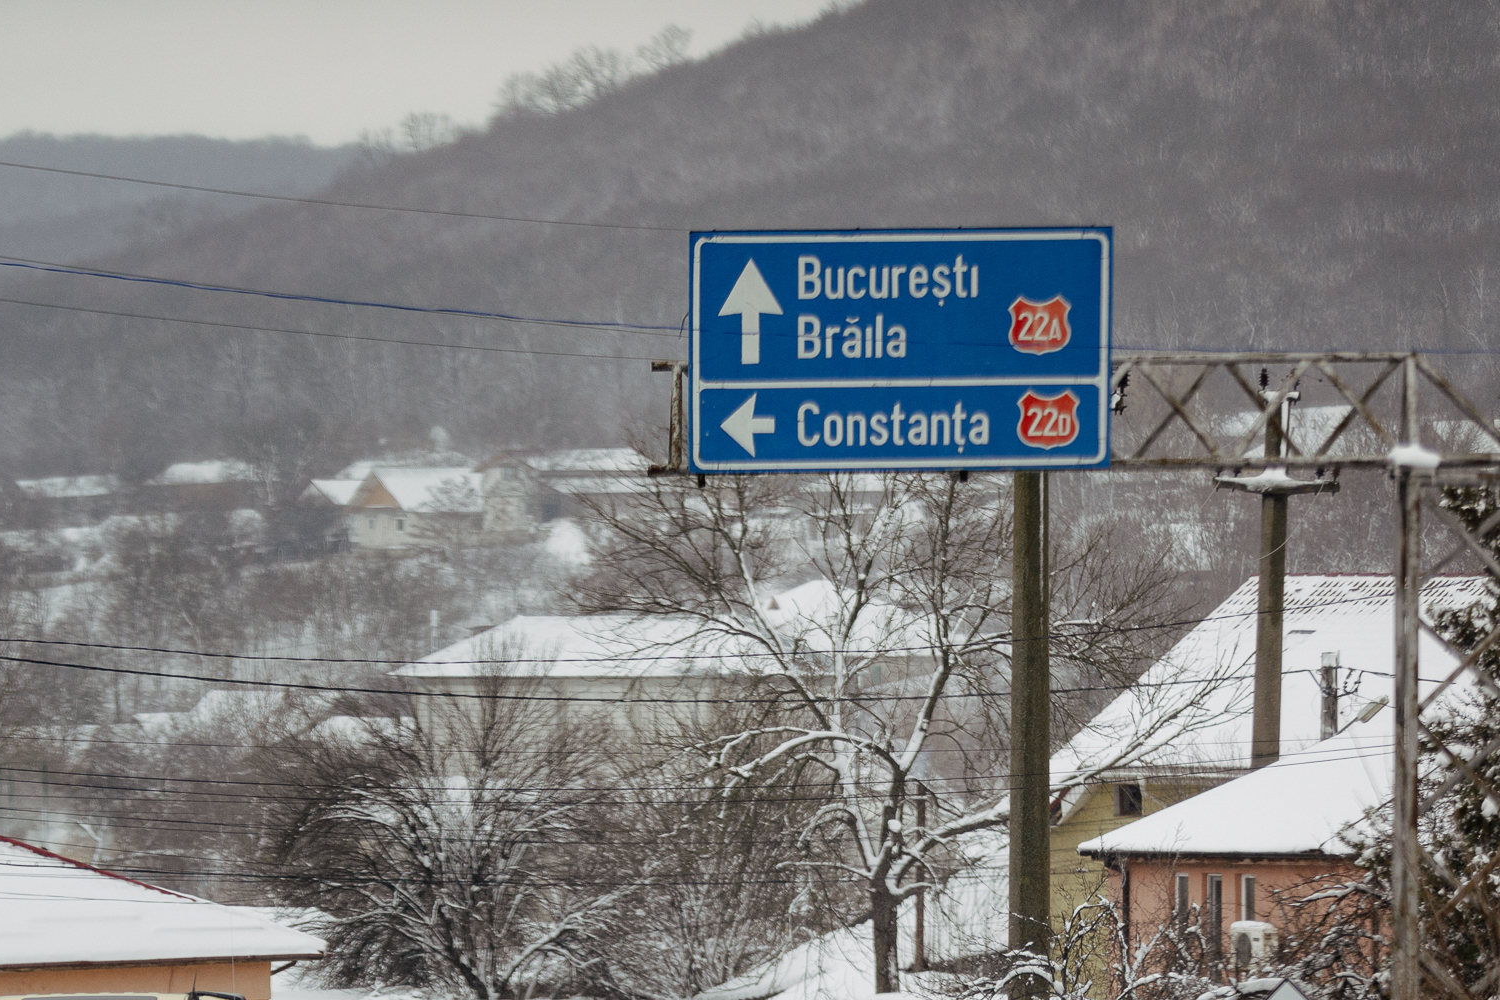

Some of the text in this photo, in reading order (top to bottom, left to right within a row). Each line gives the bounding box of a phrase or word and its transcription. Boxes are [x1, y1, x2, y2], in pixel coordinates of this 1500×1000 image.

[1017, 312, 1063, 342] 22A
[797, 400, 990, 455] Constanța
[1026, 407, 1072, 437] 22D
